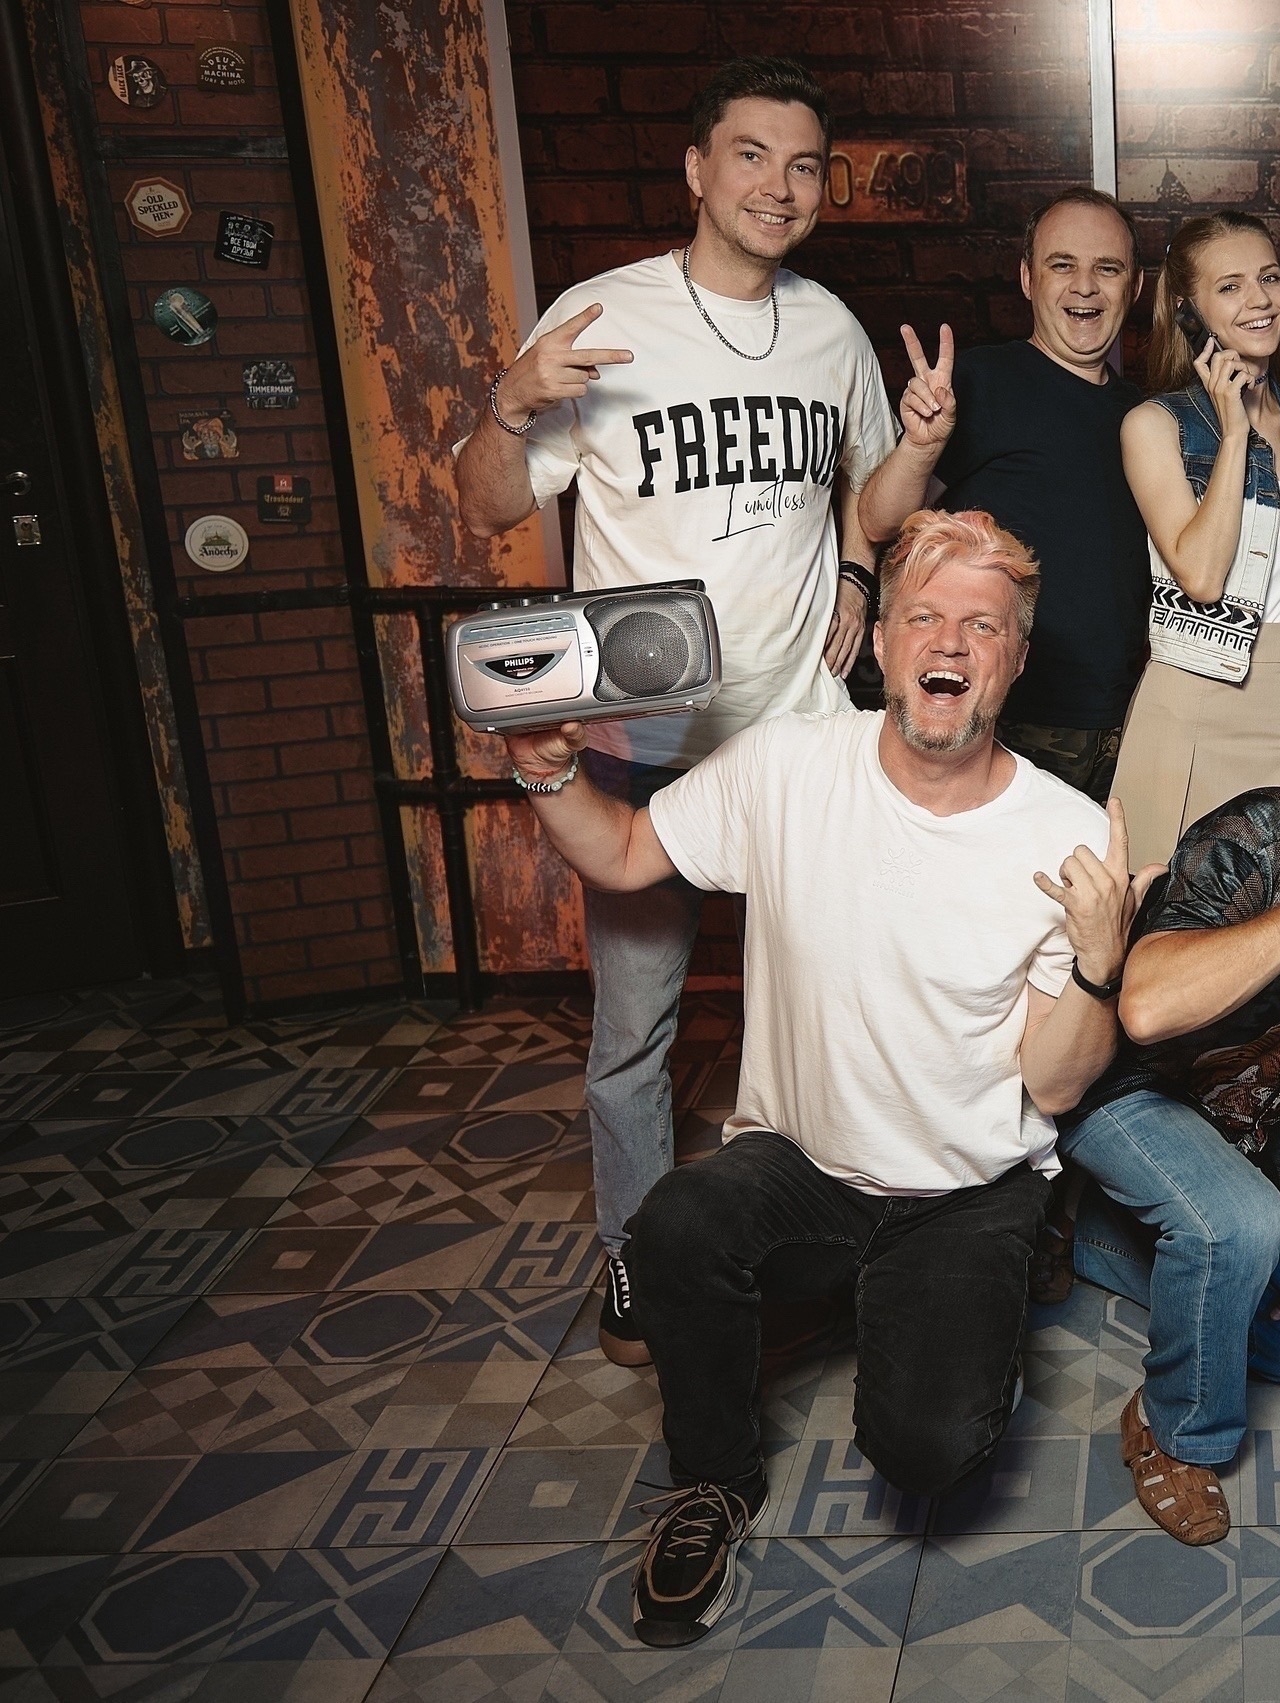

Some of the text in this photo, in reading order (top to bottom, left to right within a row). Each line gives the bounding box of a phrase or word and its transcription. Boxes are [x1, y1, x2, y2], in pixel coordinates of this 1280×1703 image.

[207, 56, 236, 67] DEUS
[115, 64, 124, 79] JACK
[203, 70, 242, 79] MACHINA
[146, 194, 164, 204] OLD
[137, 200, 179, 216] SPECKLED
[152, 210, 171, 222] HEN
[230, 236, 242, 246] ВСЕ
[231, 245, 254, 257] ДРУЗЬЯ
[248, 385, 294, 394] TIMMERMANS
[504, 657, 534, 667] PHILIPS
